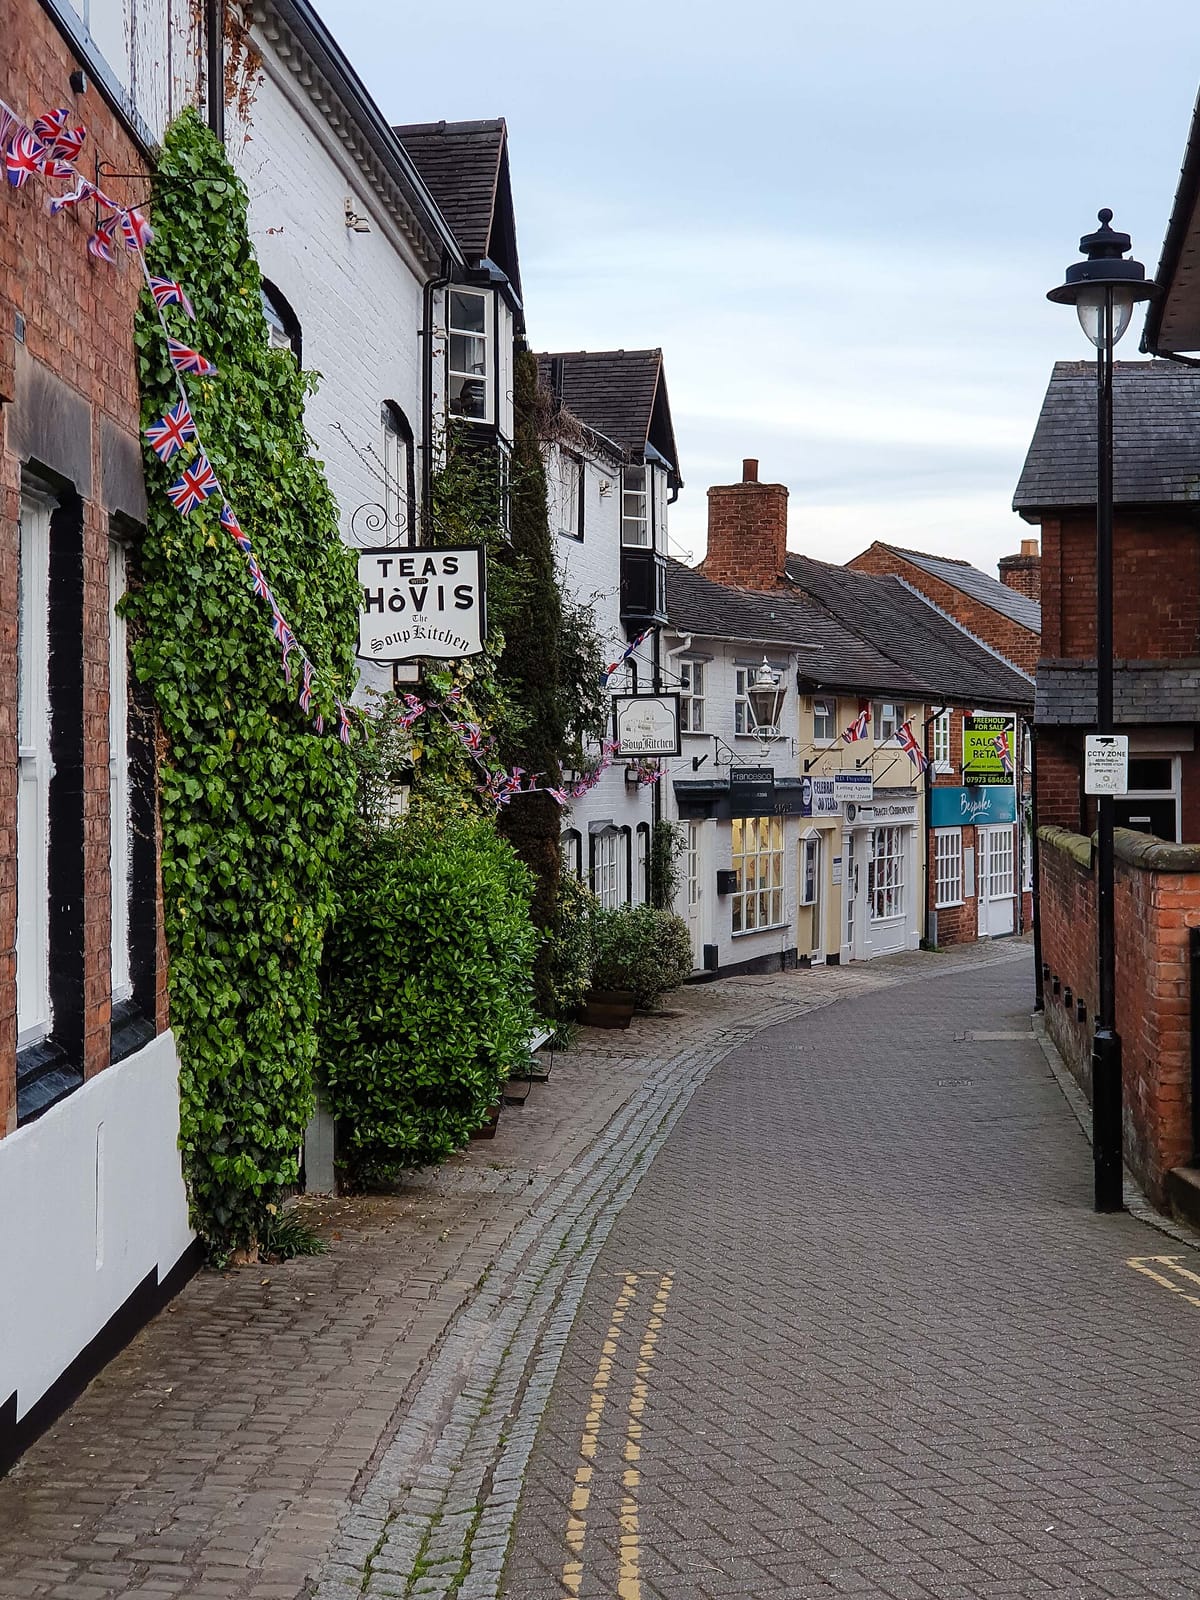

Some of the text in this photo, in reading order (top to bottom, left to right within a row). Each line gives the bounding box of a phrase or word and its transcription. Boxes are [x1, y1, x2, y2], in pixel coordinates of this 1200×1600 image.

[377, 556, 459, 578] TEAS
[412, 614, 428, 623] The
[370, 624, 471, 654] Soup Kitchen
[643, 738, 674, 750] Kitchen
[732, 772, 772, 780] Francesco
[960, 789, 992, 820] Bespoke
